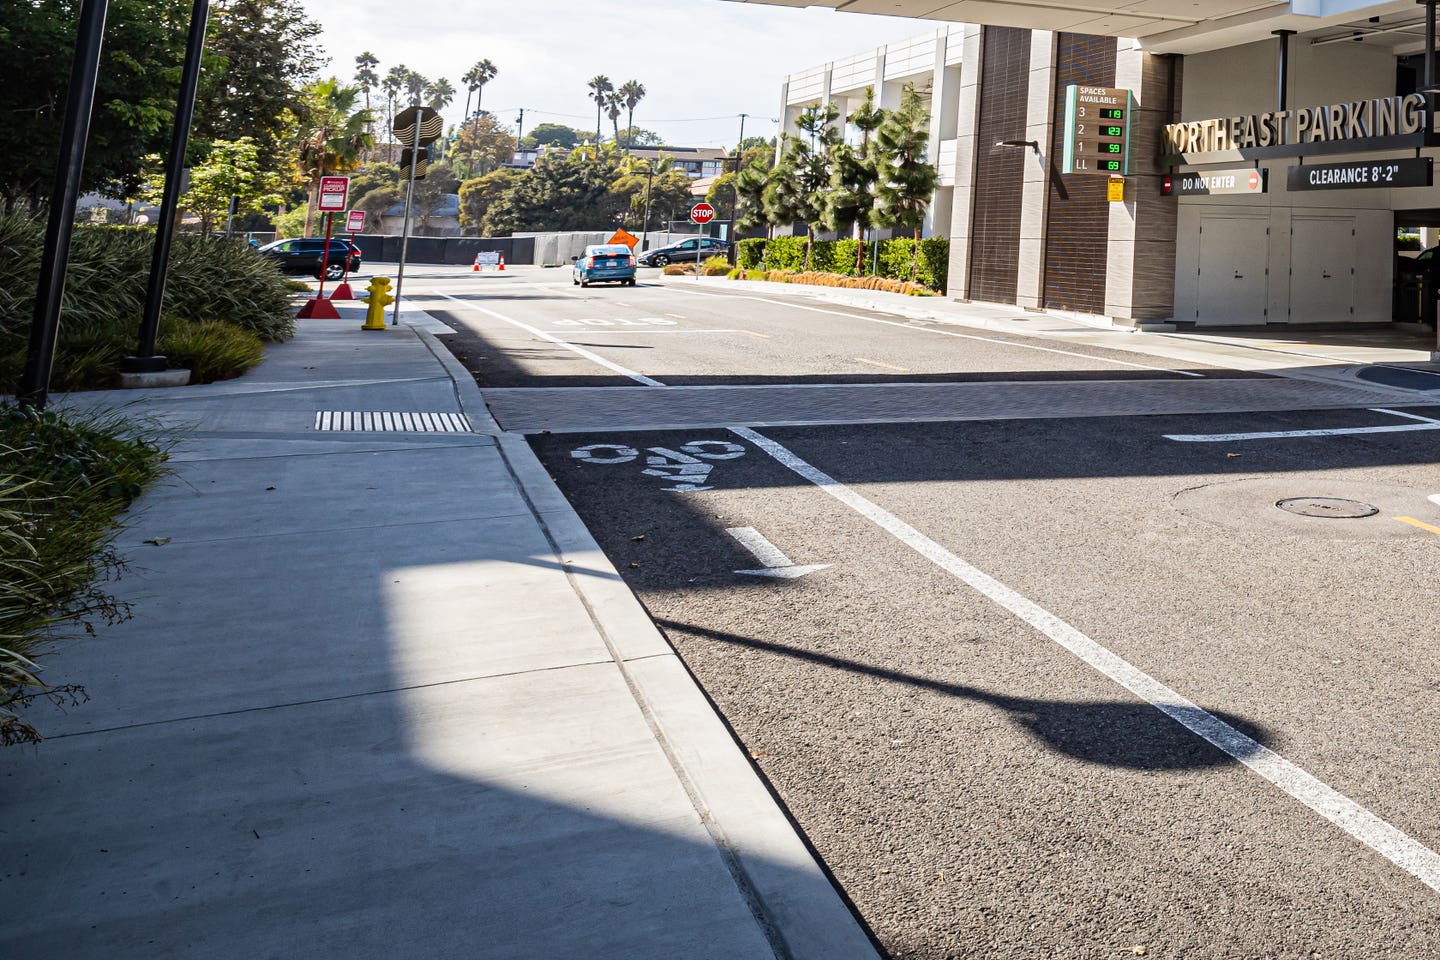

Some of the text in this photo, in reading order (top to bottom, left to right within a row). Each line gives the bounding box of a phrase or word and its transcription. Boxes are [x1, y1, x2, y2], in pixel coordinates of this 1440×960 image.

[1080, 87, 1106, 95] SPACES
[1080, 95, 1117, 104] AVAILABLE
[1079, 107, 1086, 117] 3
[1108, 110, 1121, 119] 119
[1296, 93, 1426, 143] PARKING
[1078, 124, 1085, 135] 2
[1108, 127, 1121, 136] 123
[1078, 142, 1083, 152] 1
[1109, 144, 1120, 153] 59
[1076, 159, 1087, 170] LL
[1108, 161, 1119, 170] 69
[1309, 165, 1399, 185] CLEARANCE 8'-2"
[1182, 175, 1235, 190] DO NOT ENTER
[693, 209, 713, 218] STOP
